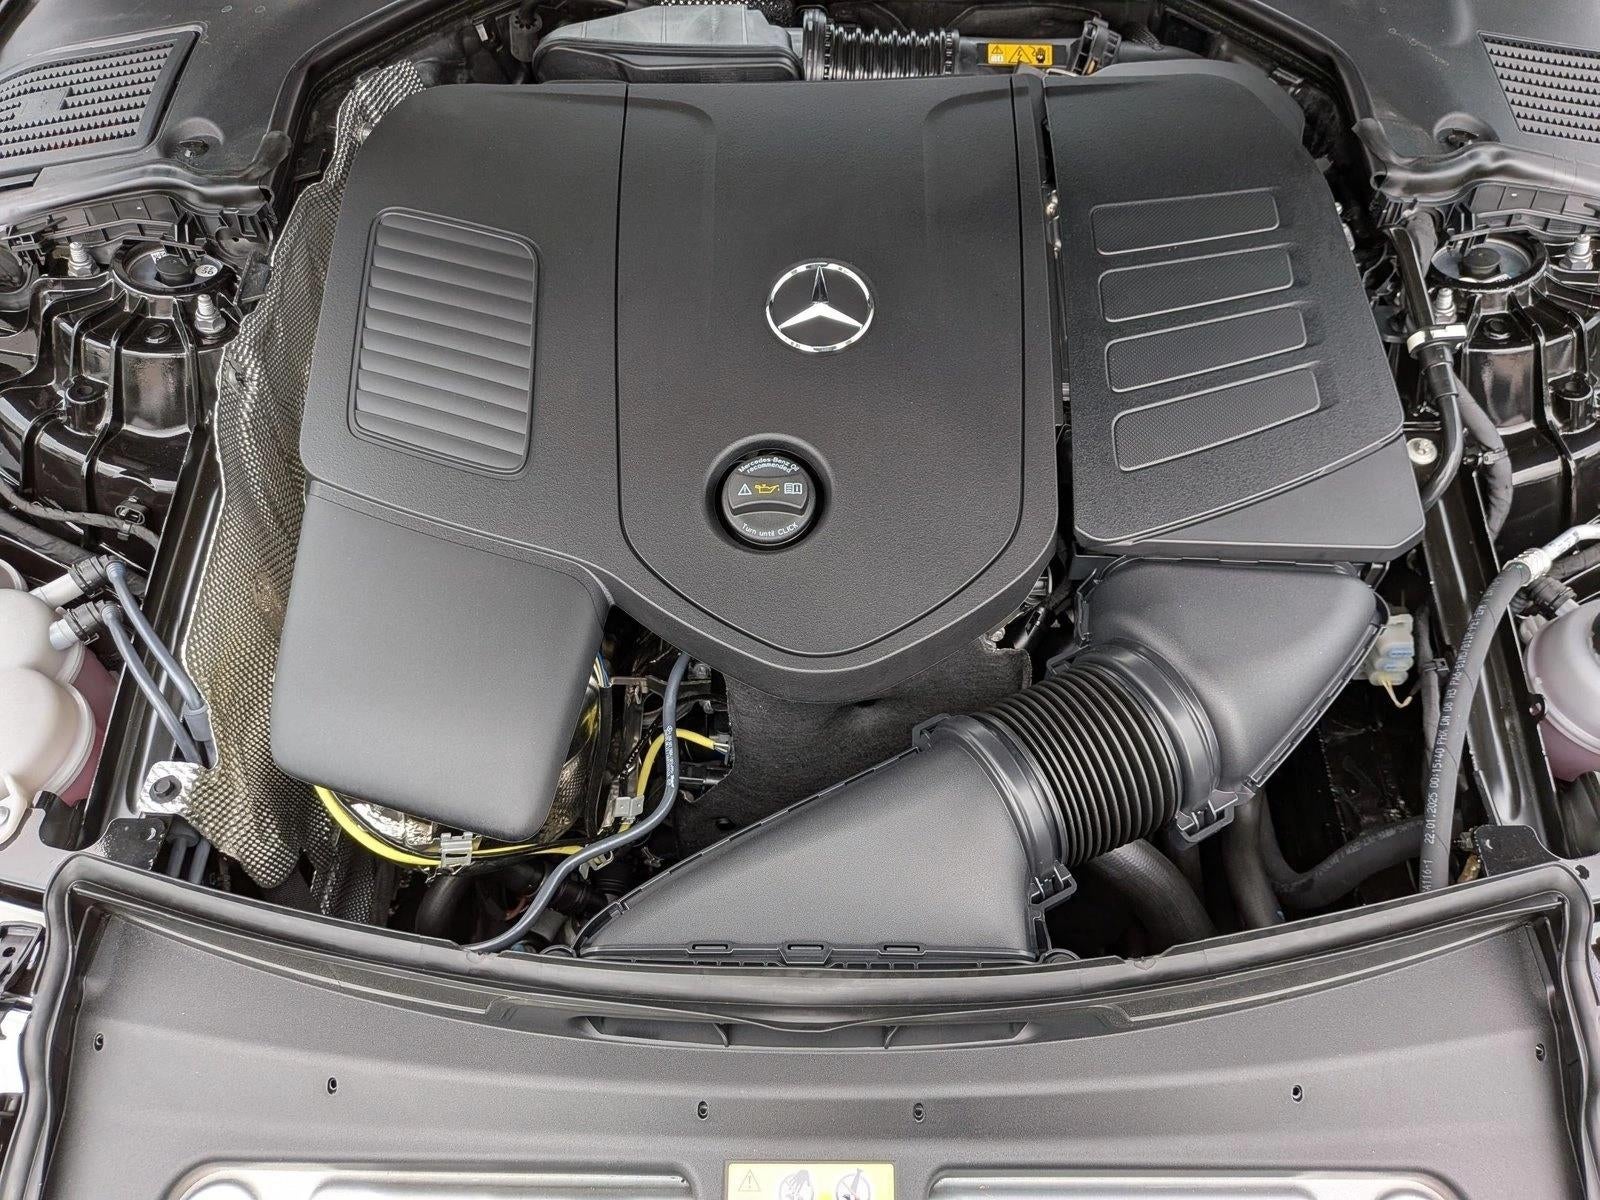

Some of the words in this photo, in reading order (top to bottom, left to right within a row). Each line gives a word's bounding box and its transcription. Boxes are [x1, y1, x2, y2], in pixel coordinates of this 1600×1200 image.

[747, 463, 791, 473] recommended
[742, 523, 757, 535] Turn
[778, 522, 799, 535] CLICK
[1429, 747, 1445, 789] 00:15:40
[1424, 792, 1438, 845] 22.01.2025
